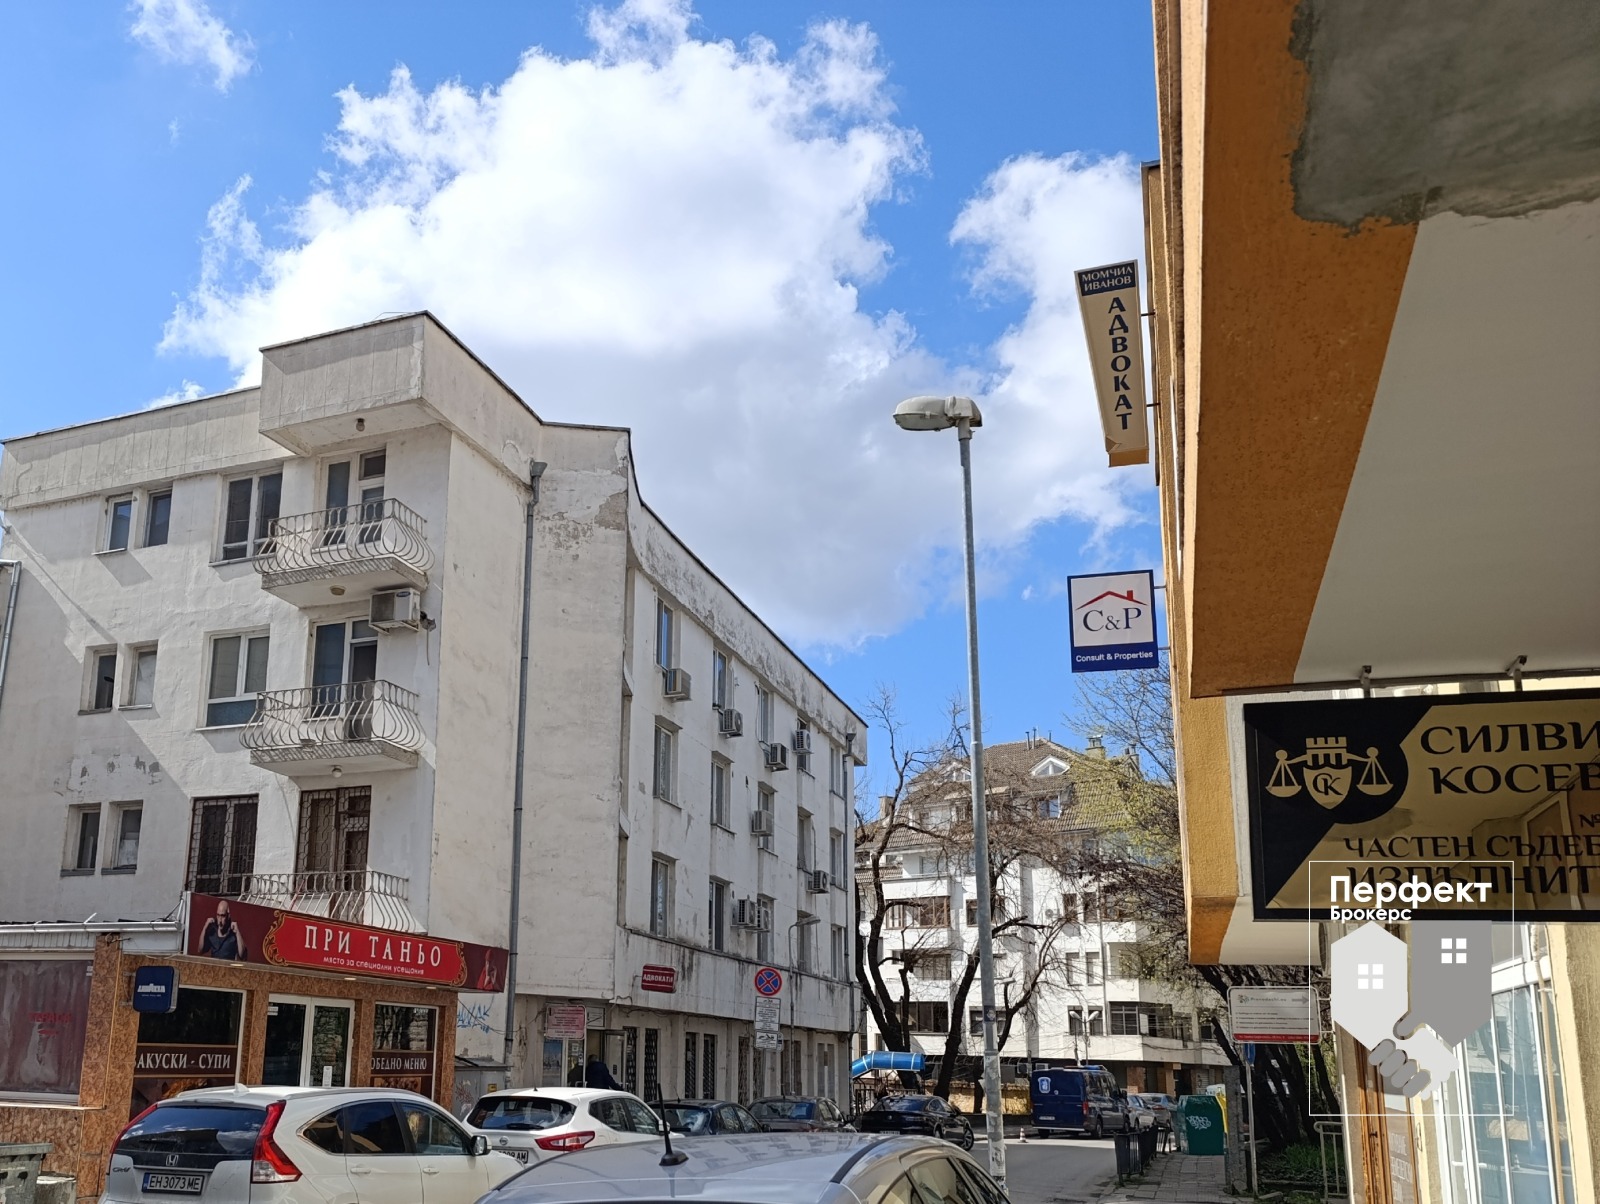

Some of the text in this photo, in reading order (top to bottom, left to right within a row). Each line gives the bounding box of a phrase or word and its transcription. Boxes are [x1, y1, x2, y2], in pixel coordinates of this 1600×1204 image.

[1082, 266, 1133, 282] МОМЧИЛ
[1084, 275, 1132, 292] ИВАНОВ
[1108, 296, 1133, 430] АДВОКАТ
[1082, 607, 1142, 632] C&P
[1075, 654, 1105, 663] Consult
[1114, 651, 1154, 661] Properties
[1420, 720, 1600, 755] СИЛВИ
[1428, 762, 1600, 794] КОСЕВ
[1343, 835, 1477, 858] ЧАСТЕН
[304, 925, 441, 967] ПРИ ТАНЬО
[323, 956, 424, 975] място за специални усещания
[135, 1053, 188, 1069] АКУСКИ
[198, 1053, 231, 1069] СУПИ
[371, 1057, 427, 1070] ОБЕДНО МЕНЮ
